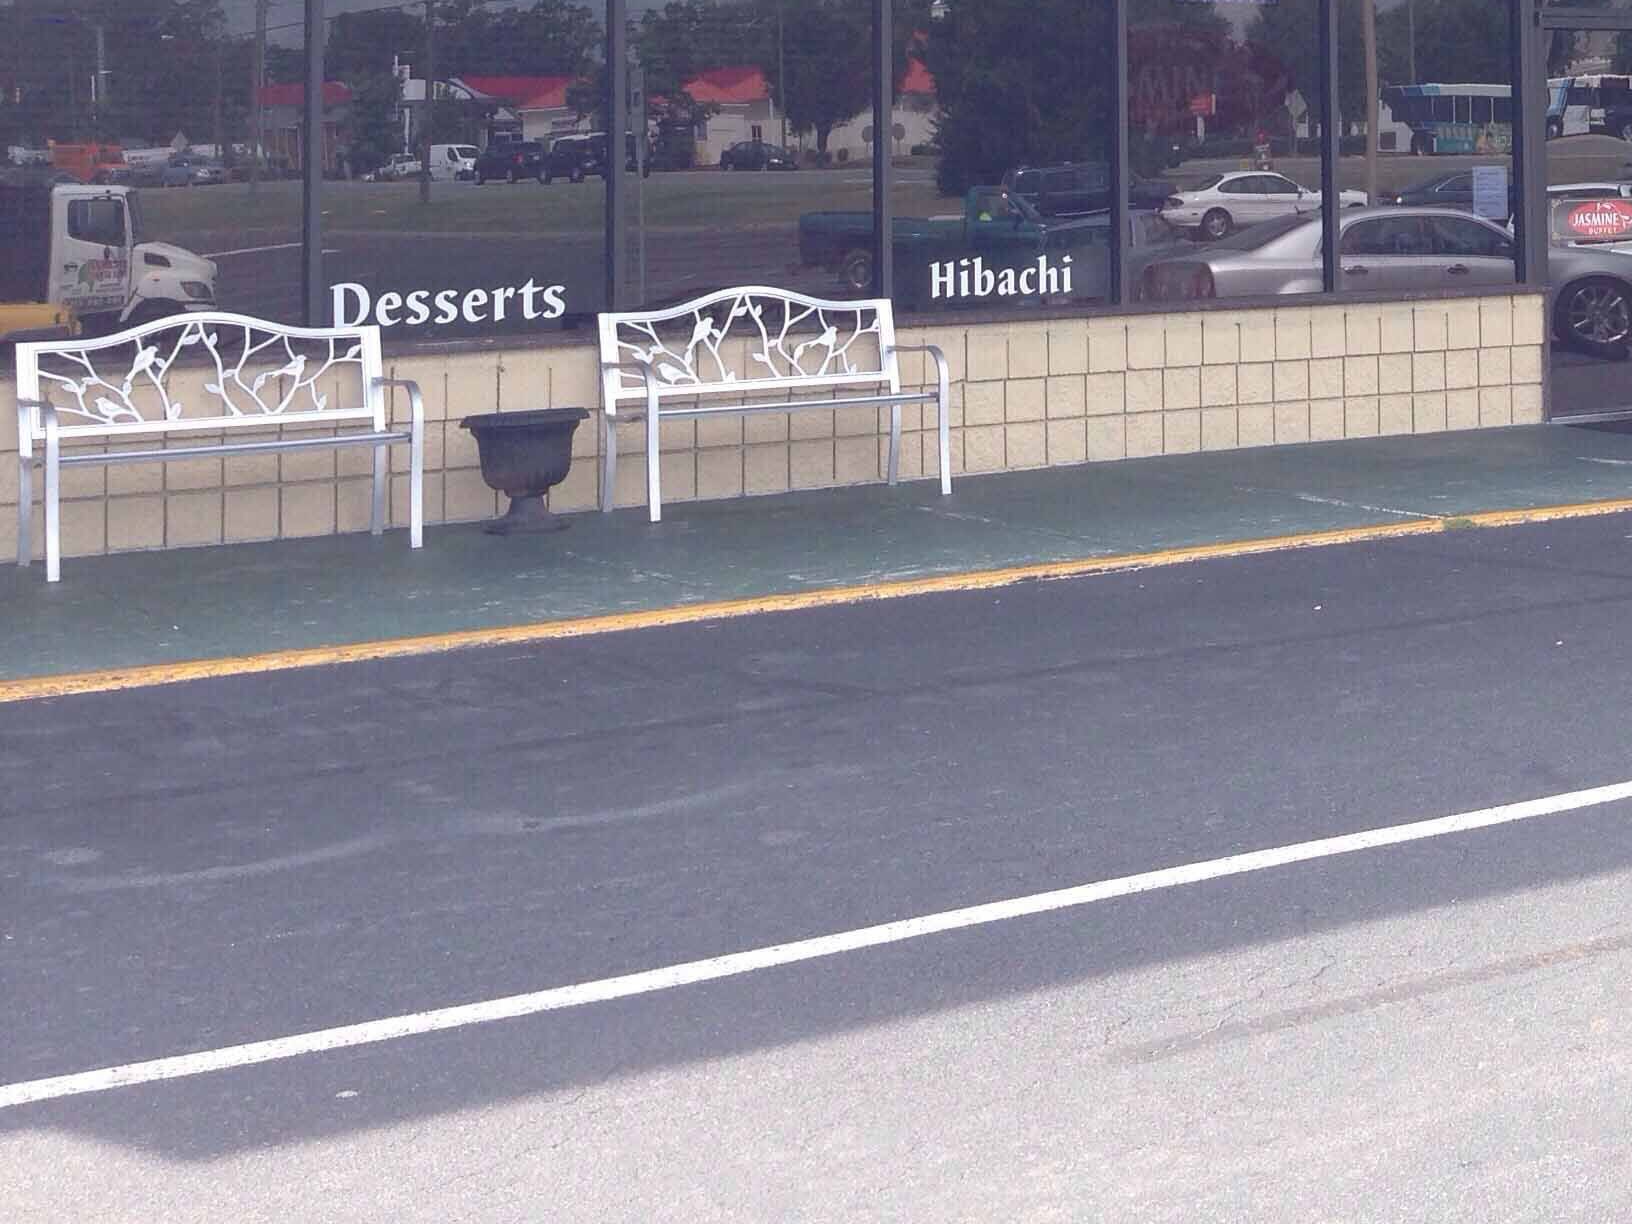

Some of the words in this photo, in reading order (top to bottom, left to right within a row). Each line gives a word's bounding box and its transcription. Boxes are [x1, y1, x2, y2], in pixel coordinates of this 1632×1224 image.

[1572, 212, 1619, 226] JASMINE
[929, 254, 1073, 299] Hibachi
[329, 277, 567, 327] Desserts
